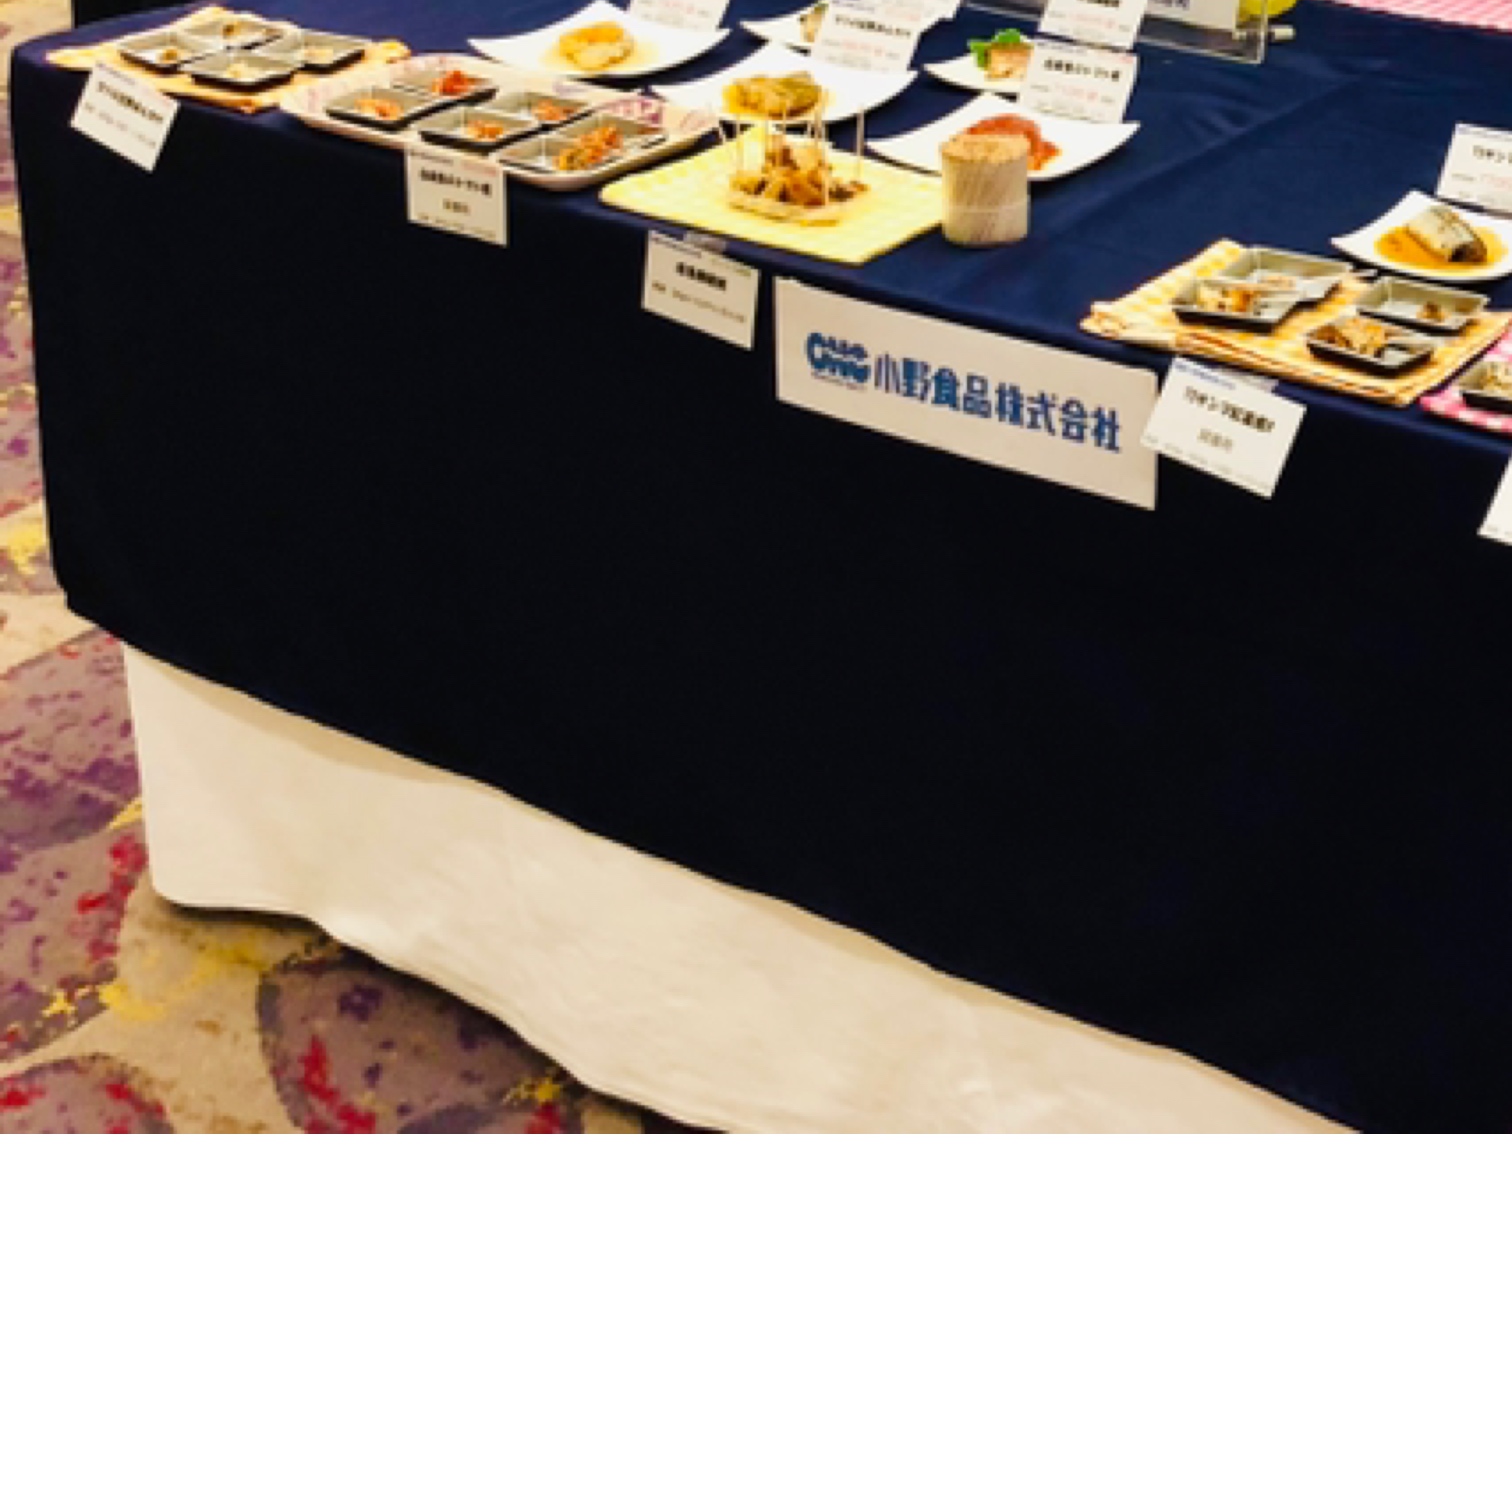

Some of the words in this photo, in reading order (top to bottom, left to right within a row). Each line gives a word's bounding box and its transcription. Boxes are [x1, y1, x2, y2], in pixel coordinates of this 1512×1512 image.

[874, 351, 1122, 454] 小野食品株式会社
